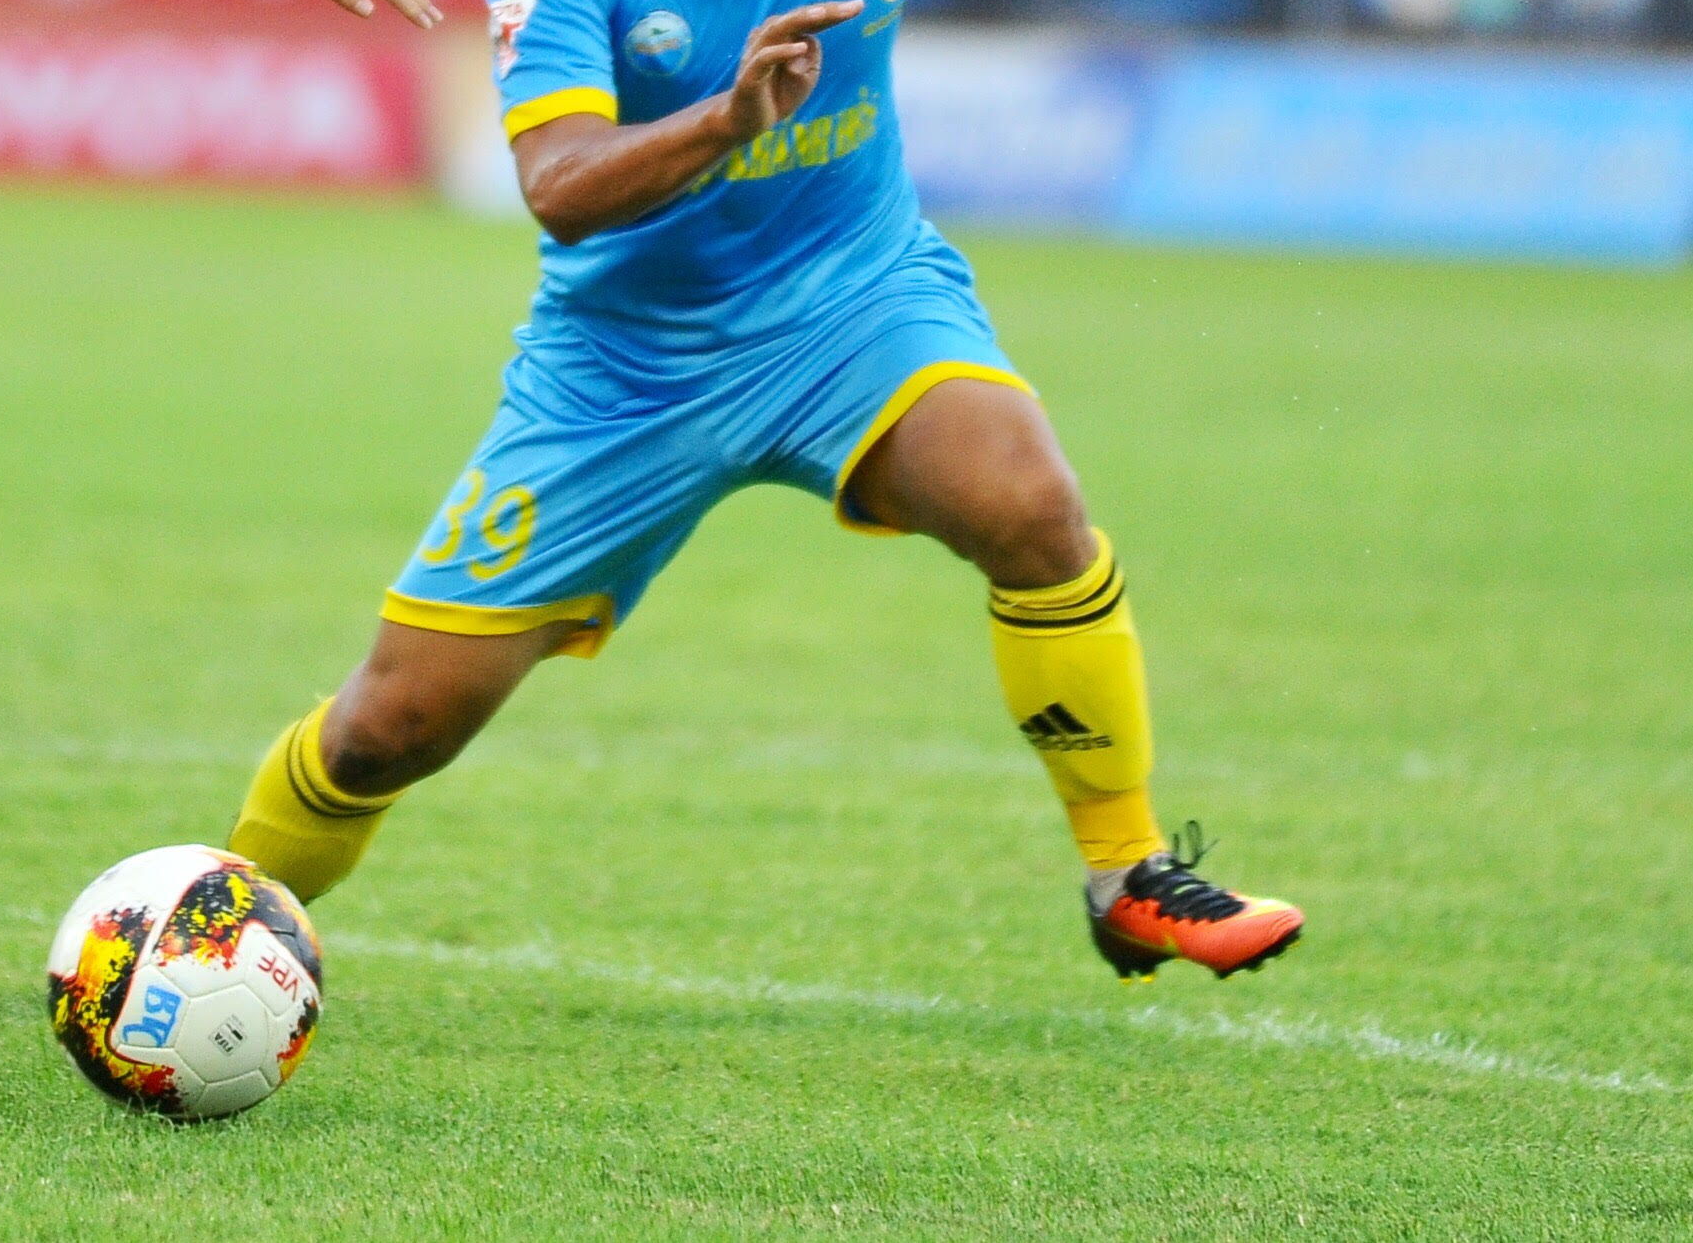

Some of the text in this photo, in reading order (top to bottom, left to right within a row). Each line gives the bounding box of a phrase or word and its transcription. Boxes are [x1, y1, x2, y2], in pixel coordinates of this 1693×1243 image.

[420, 466, 536, 581] 39
[257, 956, 300, 1003] VPF
[212, 1031, 236, 1054] FIFA
